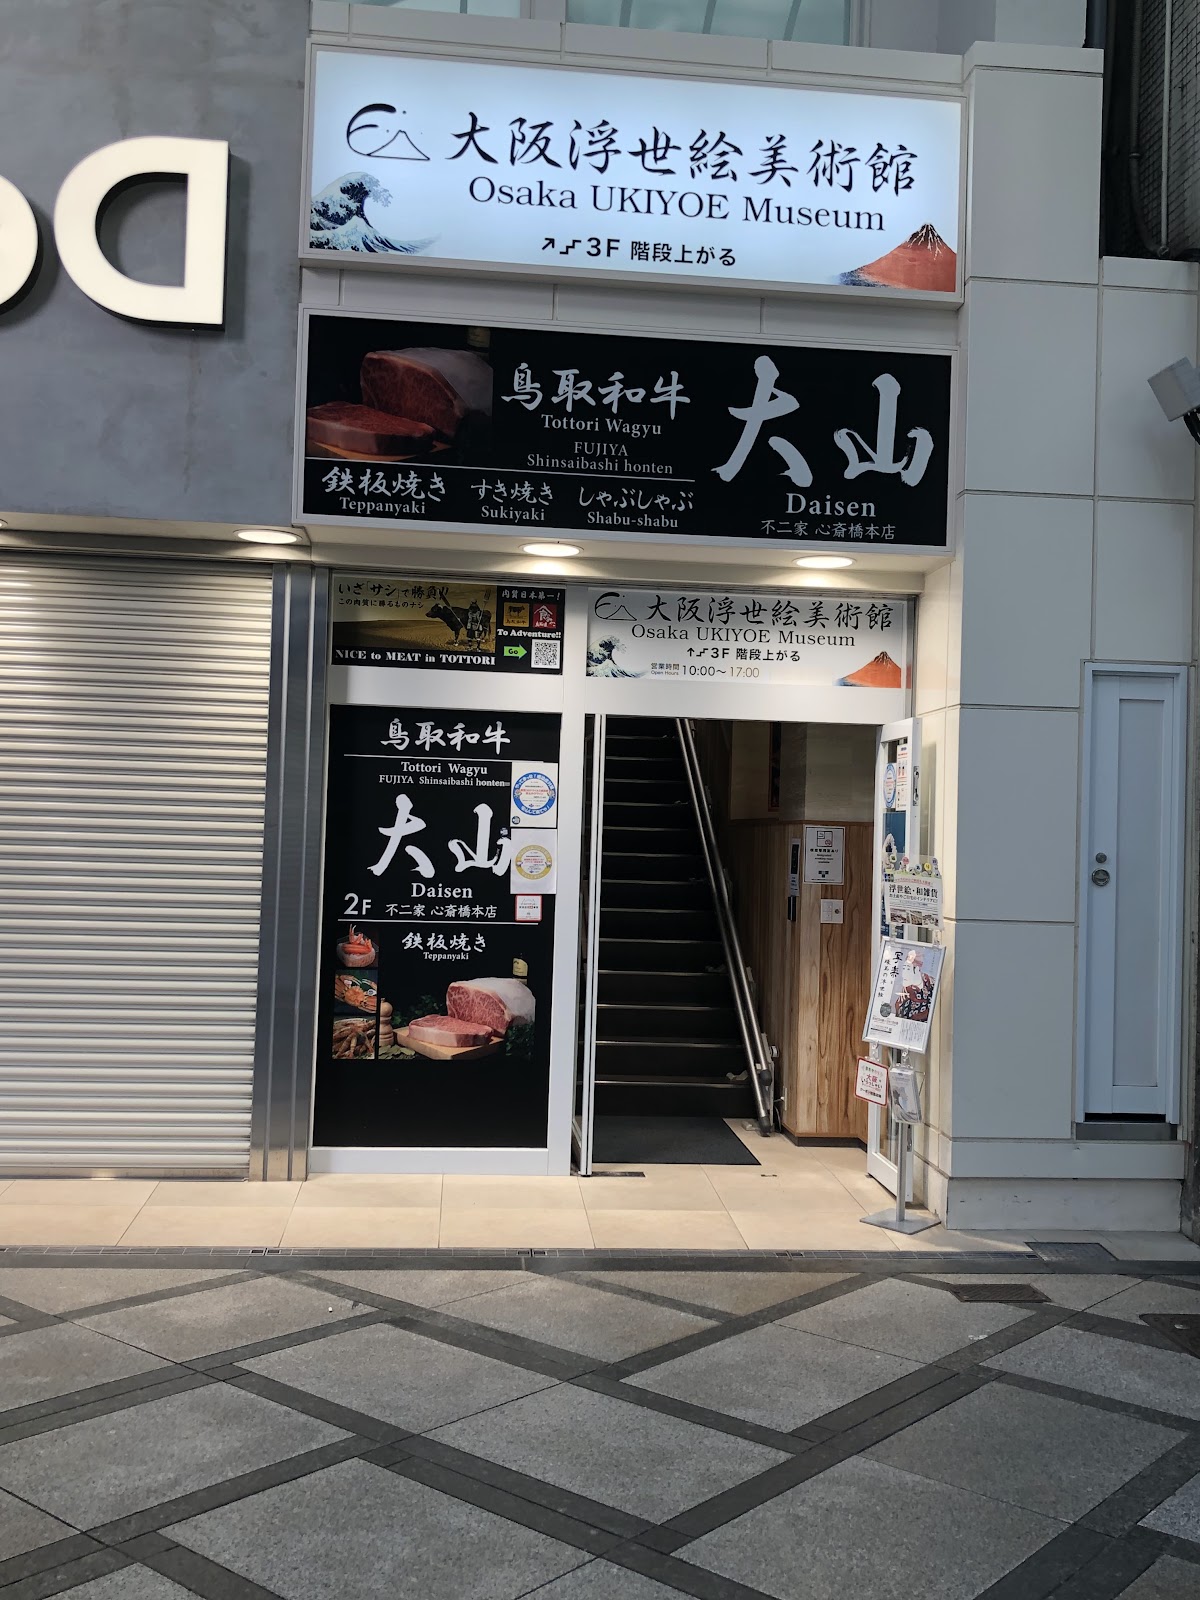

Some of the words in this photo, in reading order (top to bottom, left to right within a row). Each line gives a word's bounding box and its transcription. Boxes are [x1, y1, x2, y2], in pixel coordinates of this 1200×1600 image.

[450, 111, 919, 198] 大阪浮世絵美術館
[469, 177, 577, 210] Osaka
[592, 184, 729, 220] UKIYOE
[742, 197, 886, 232] Museum
[586, 237, 621, 258] 3F
[630, 241, 737, 267] 階段上がる
[501, 363, 692, 421] 鳥取和牛
[541, 413, 600, 432] Tottori
[605, 418, 663, 437] Wagyu
[710, 355, 935, 487] 大山
[573, 440, 629, 457] FUJIYA
[527, 452, 619, 473] Shinsaibashi
[624, 459, 674, 475] honten
[322, 465, 448, 502] 鉄板焼き
[471, 479, 555, 506] すき焼き
[339, 496, 427, 517] Teppanyaki
[578, 485, 695, 513] しゃぶしゃぶ
[785, 492, 878, 518] Daisen
[481, 504, 546, 523] Sukiyaki
[587, 510, 680, 529] Shabu-shabu
[761, 518, 809, 536] 不二家
[814, 521, 897, 541] 心斎橋本店
[646, 594, 895, 632] 大阪浮世絵美術館
[497, 628, 509, 636] To
[510, 629, 562, 638] Adventure!!
[631, 623, 689, 641] Osaka
[696, 627, 771, 644] UKIYOE
[778, 630, 856, 647] Museum
[335, 649, 367, 660] NICE
[370, 651, 381, 660] to
[385, 651, 422, 662] MEAT
[425, 653, 436, 663] in
[439, 653, 496, 666] TOTTORI
[650, 662, 680, 671] 営業時間
[710, 648, 730, 659] 3F
[736, 648, 801, 662] 階段上がる
[380, 717, 511, 755] 鳥取和牛
[401, 761, 442, 774] Tottori
[448, 763, 488, 776] Wagyu
[379, 774, 415, 784] FUJIYA
[419, 777, 474, 787] Shinsaibashi
[475, 778, 505, 787] honten
[367, 793, 511, 878] 大山
[411, 882, 473, 899] Daisen
[343, 892, 372, 916] 2F
[385, 903, 426, 917] 不二家
[431, 904, 498, 919] 心斎橋本店
[401, 931, 487, 953] 鉄板焼き
[423, 952, 469, 961] Teppanyaki
